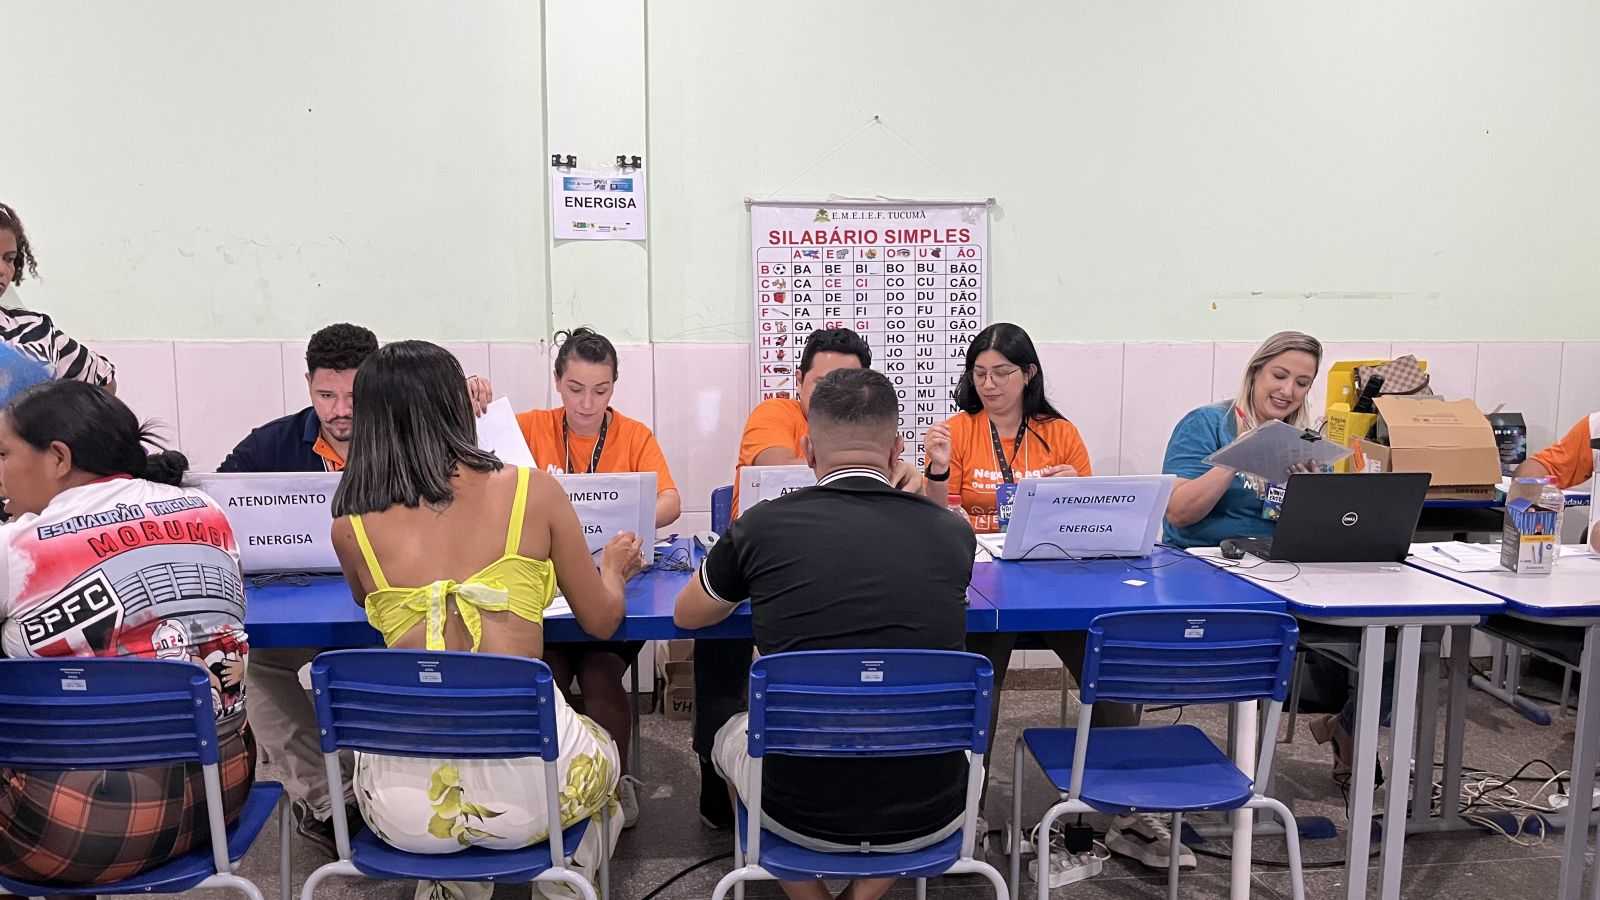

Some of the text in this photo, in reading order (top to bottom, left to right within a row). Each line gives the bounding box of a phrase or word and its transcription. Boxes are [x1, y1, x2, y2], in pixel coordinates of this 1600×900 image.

[565, 196, 636, 208] ENERGISA
[769, 226, 970, 244] SILABÁRIO SIMPLES
[887, 249, 895, 258] O
[919, 249, 926, 257] U
[958, 247, 975, 258] ÃO
[761, 263, 977, 275] B BA BE BI BO BU BÃO
[762, 276, 976, 288] C CA CE CI CO CU CÃO
[762, 291, 976, 302] D DA DE DI DO DU DÃO
[795, 308, 810, 316] FA
[826, 307, 840, 316] FE
[856, 307, 866, 315] FI
[887, 306, 903, 315] FO
[918, 306, 932, 314] FU
[951, 304, 976, 315] FÃO
[763, 323, 771, 331] G
[795, 322, 812, 330] GA
[856, 321, 869, 330] GI
[887, 320, 905, 329] GO
[917, 320, 934, 329] GU
[950, 319, 977, 330] GÃO
[763, 337, 770, 345] H
[887, 335, 904, 343] HO
[918, 334, 934, 342] HU
[763, 351, 768, 359] J
[887, 348, 902, 357] JO
[917, 348, 932, 356] JU
[950, 346, 965, 357] JÃ
[764, 362, 934, 373] K KO KU
[764, 379, 770, 387] L
[918, 376, 932, 384] LU
[918, 389, 935, 398] MU
[918, 403, 933, 411] NU
[917, 417, 933, 425] PU
[974, 468, 1022, 480] Negoie
[228, 494, 326, 508] ATENDIMENTO
[569, 491, 619, 502] IMENTO
[1052, 495, 1136, 505] ATENDIMENTO
[37, 503, 145, 541] ESQUADRÃO
[1059, 524, 1113, 533] ENERGISA
[87, 520, 229, 558] MORUMBI
[249, 533, 313, 546] ENERGISA
[26, 584, 109, 640] SPFC
[154, 634, 184, 650] 2024
